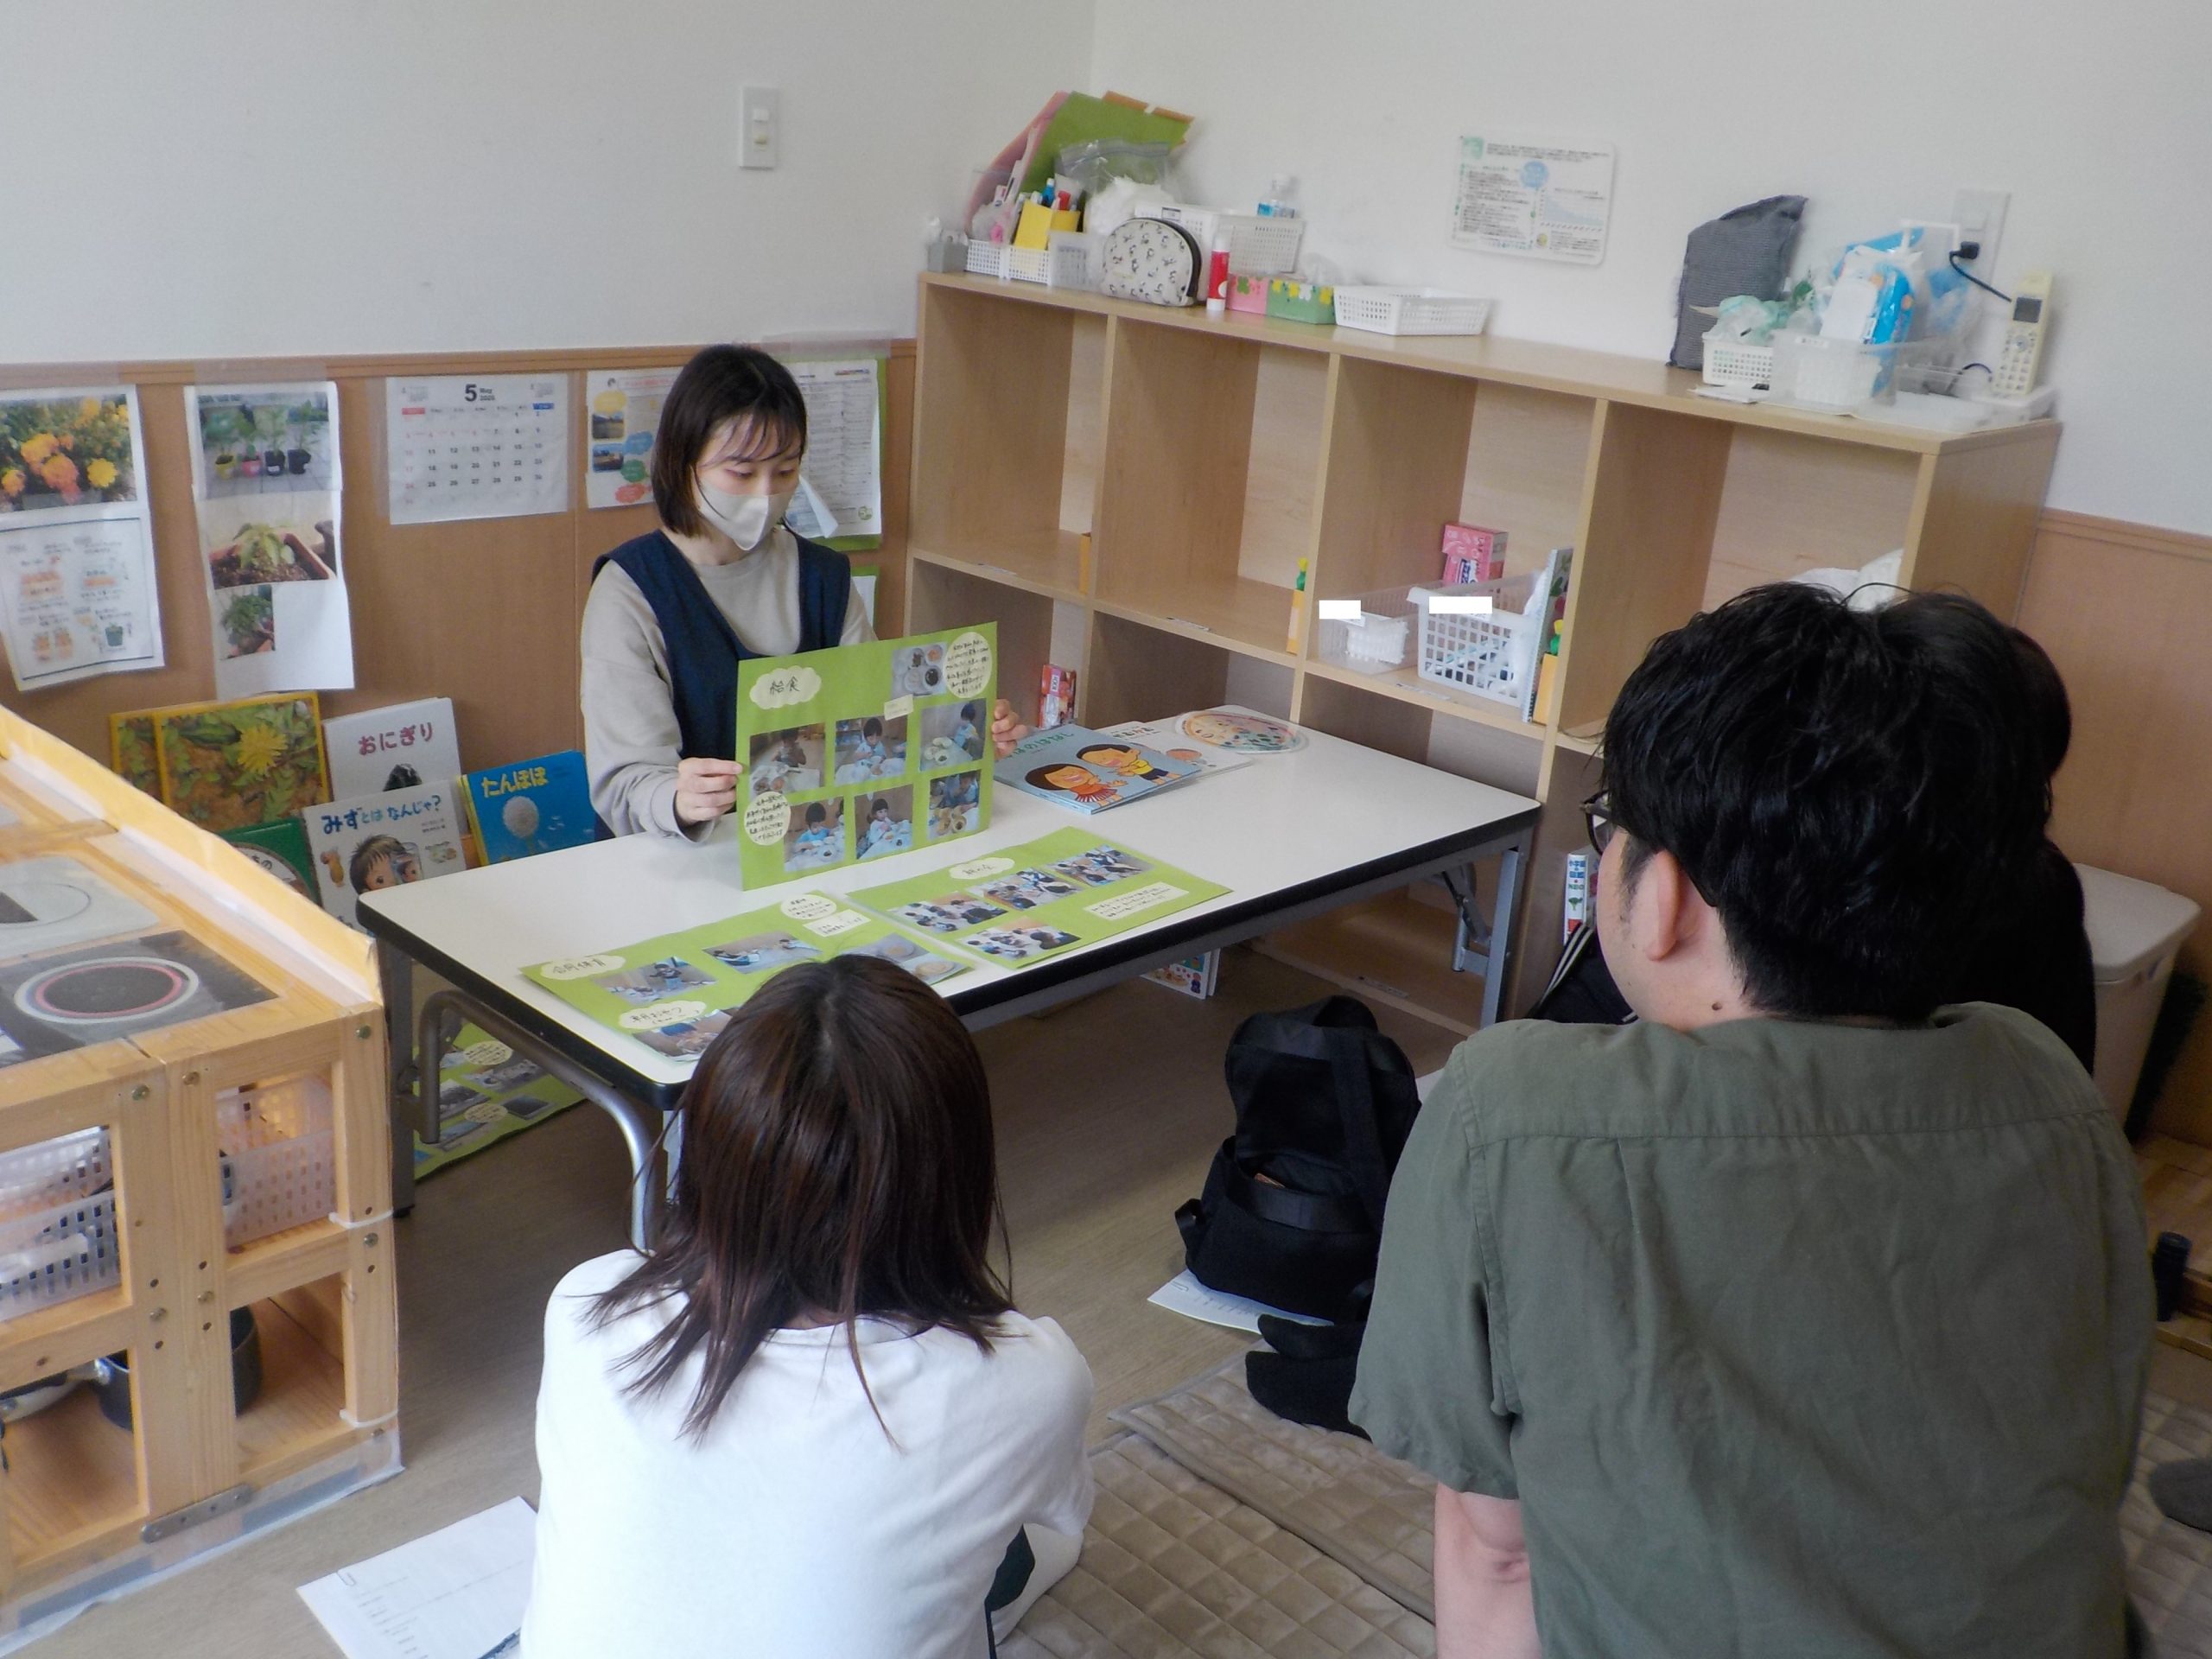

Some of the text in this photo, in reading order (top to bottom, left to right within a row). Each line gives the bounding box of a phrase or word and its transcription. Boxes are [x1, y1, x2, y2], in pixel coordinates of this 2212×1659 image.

[465, 384, 477, 402] 5
[769, 676, 801, 696] 給食
[358, 721, 433, 755] おにぎり
[321, 794, 442, 835] みずとは なんじゃ?
